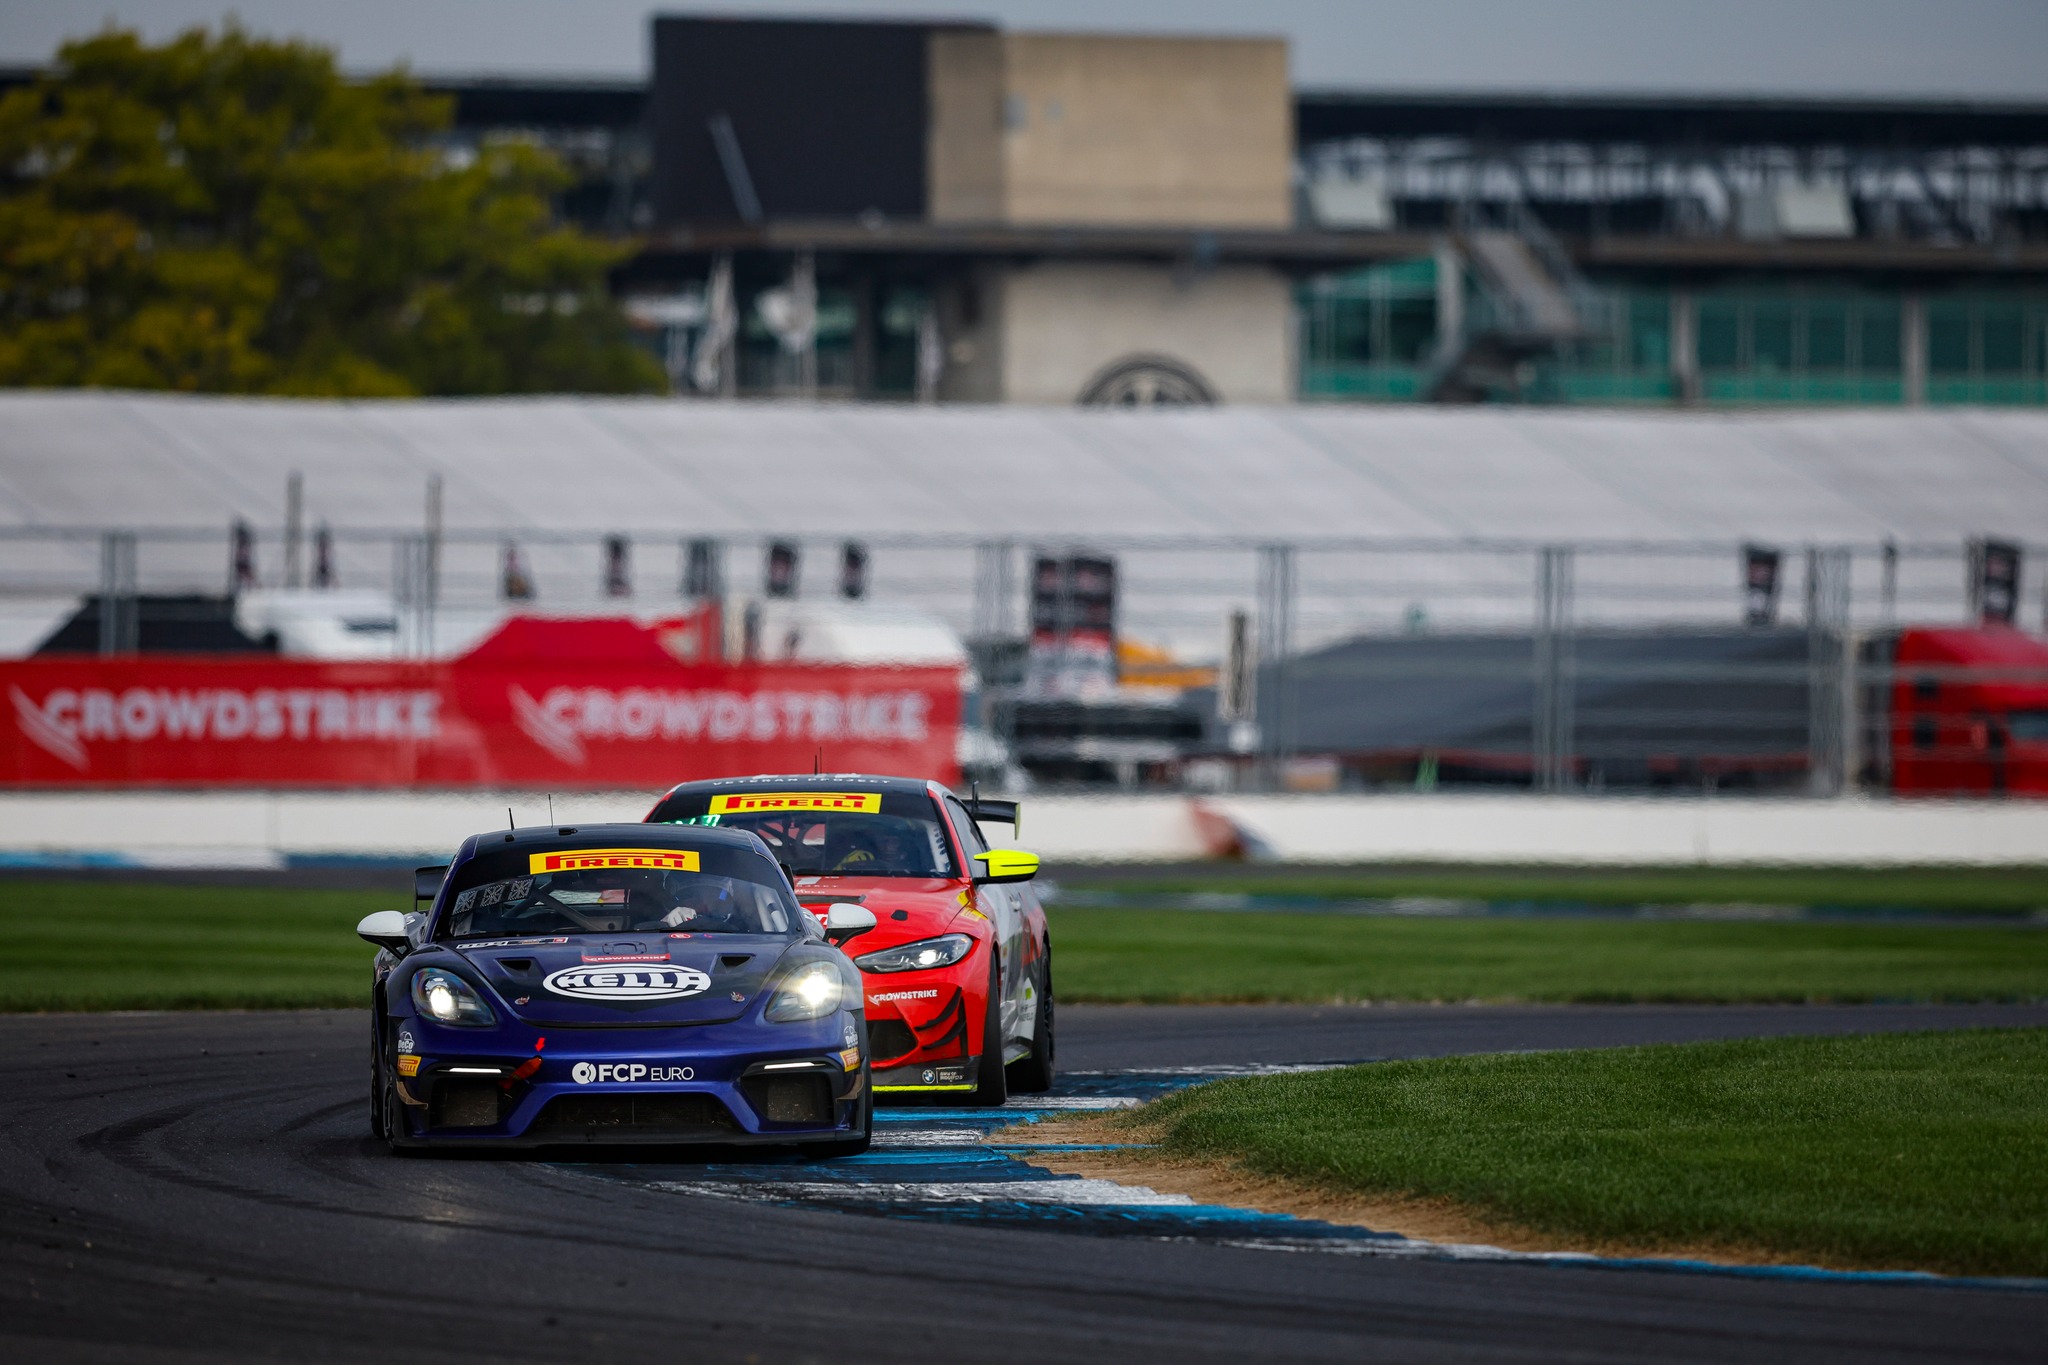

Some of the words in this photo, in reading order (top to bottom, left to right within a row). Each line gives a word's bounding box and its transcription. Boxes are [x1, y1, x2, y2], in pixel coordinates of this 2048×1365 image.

[42, 688, 438, 741] CROWDSTRIKE
[544, 687, 930, 742] CROWDSTRIKE
[726, 793, 866, 809] PIRELLI
[546, 853, 685, 870] PIRELLI
[558, 972, 711, 992] HELLA
[873, 989, 938, 1002] CROWDSTRIKE
[598, 1064, 647, 1082] FCP
[651, 1067, 694, 1081] EURO
